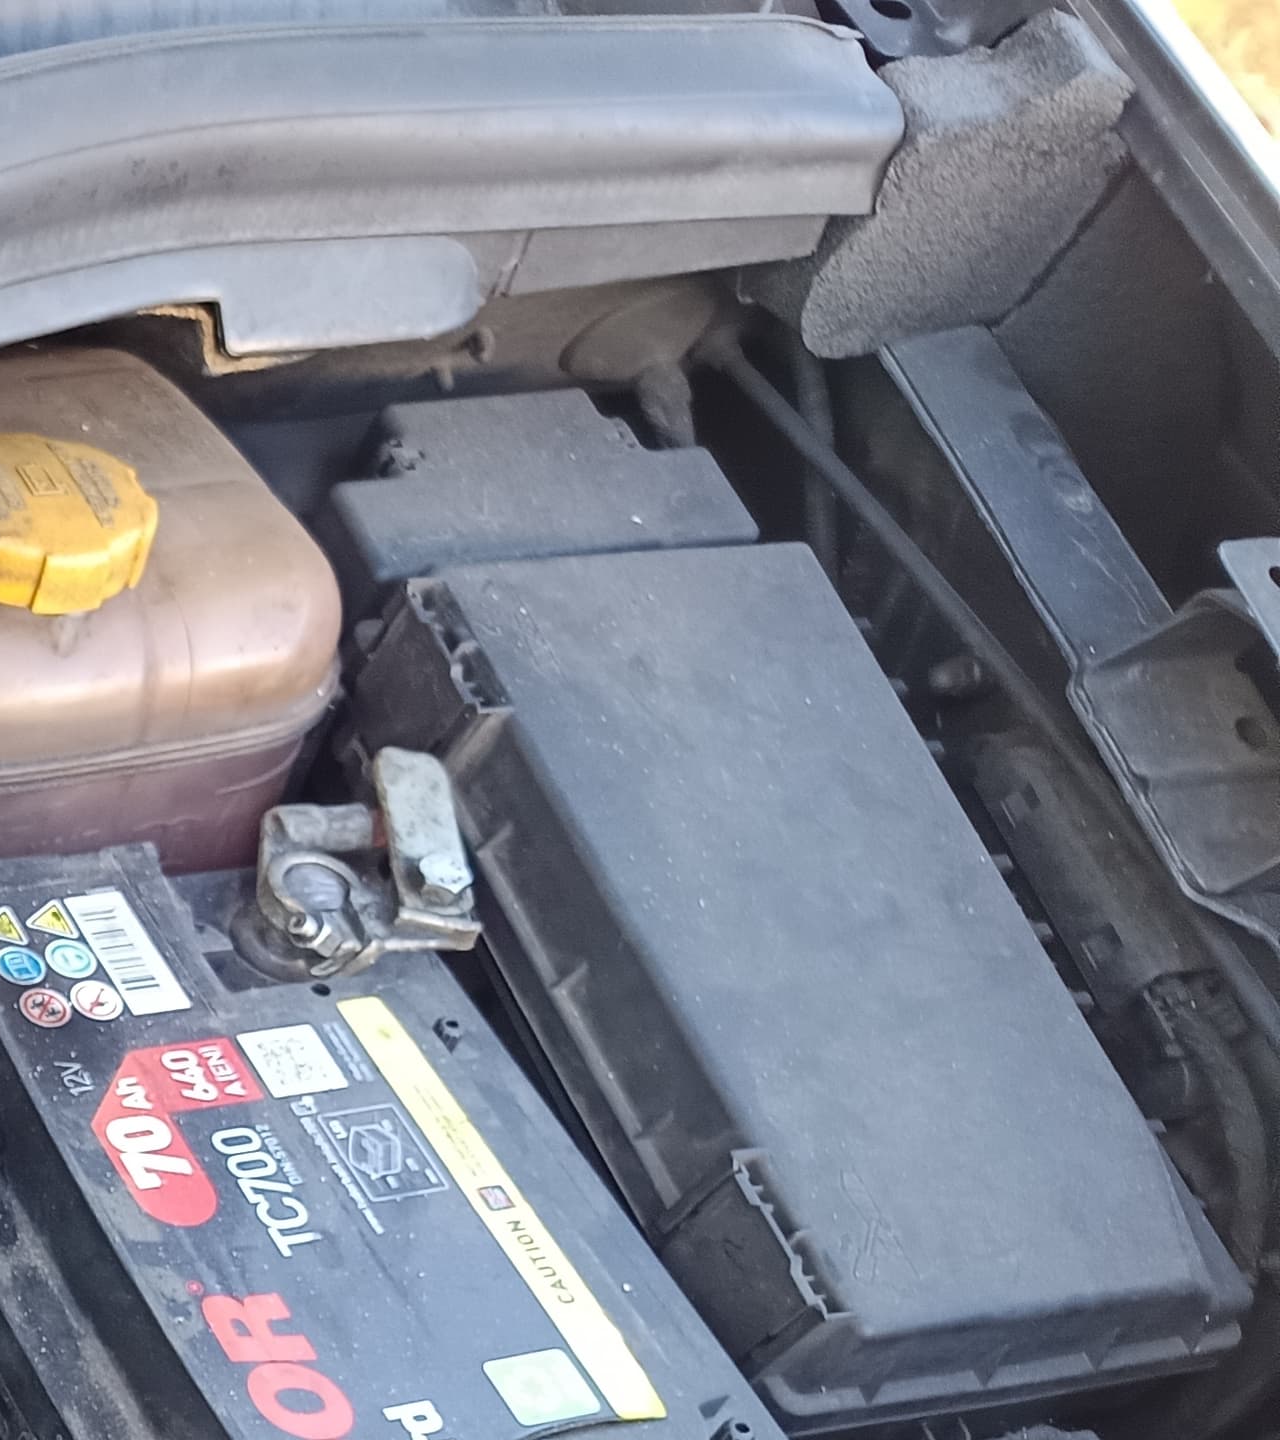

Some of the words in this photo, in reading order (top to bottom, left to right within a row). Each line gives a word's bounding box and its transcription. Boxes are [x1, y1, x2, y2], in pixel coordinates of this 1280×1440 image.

[115, 1077, 154, 1110] Ah
[161, 1050, 219, 1101] 640
[105, 1115, 194, 1190] 70
[211, 1127, 323, 1257] TC700
[506, 1220, 574, 1304] CAUTION
